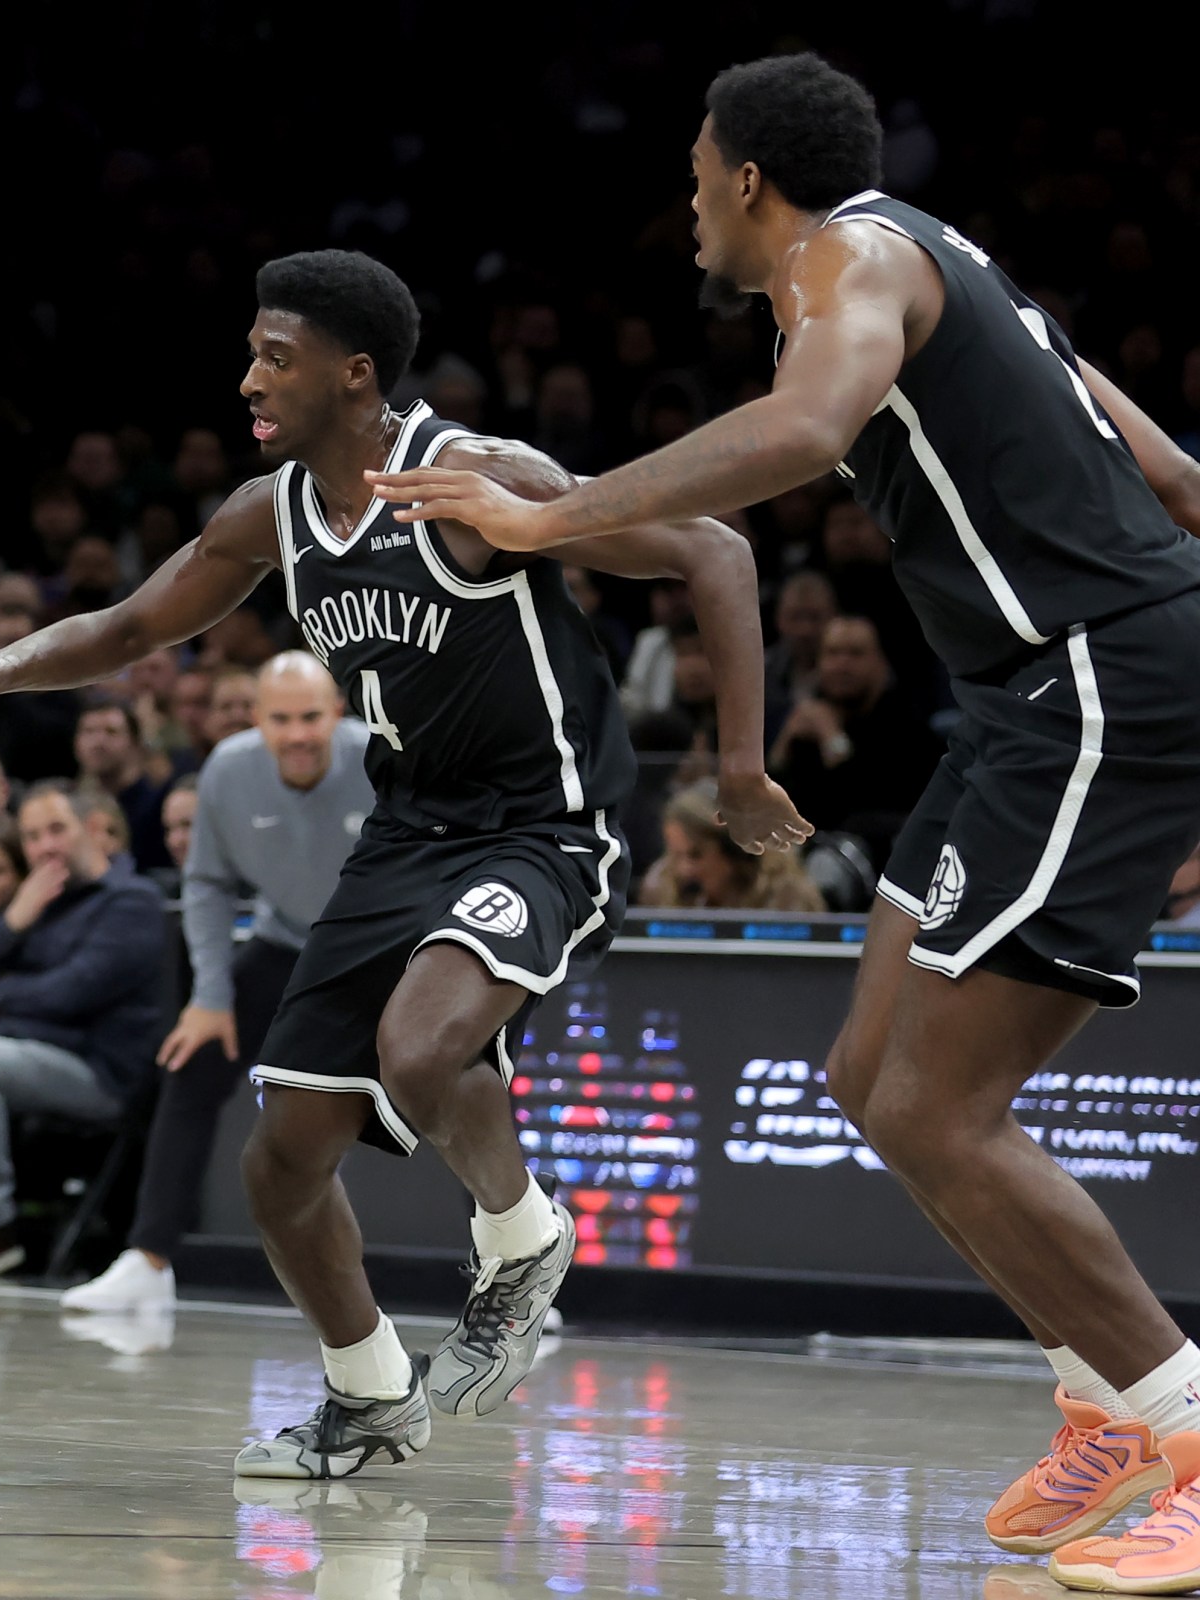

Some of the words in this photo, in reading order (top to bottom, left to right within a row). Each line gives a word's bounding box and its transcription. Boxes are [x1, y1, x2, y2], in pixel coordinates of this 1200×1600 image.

[370, 535, 383, 552] All
[382, 534, 393, 549] In
[390, 531, 411, 548] Won
[301, 588, 452, 668] BROOKLYN
[360, 669, 403, 751] 4
